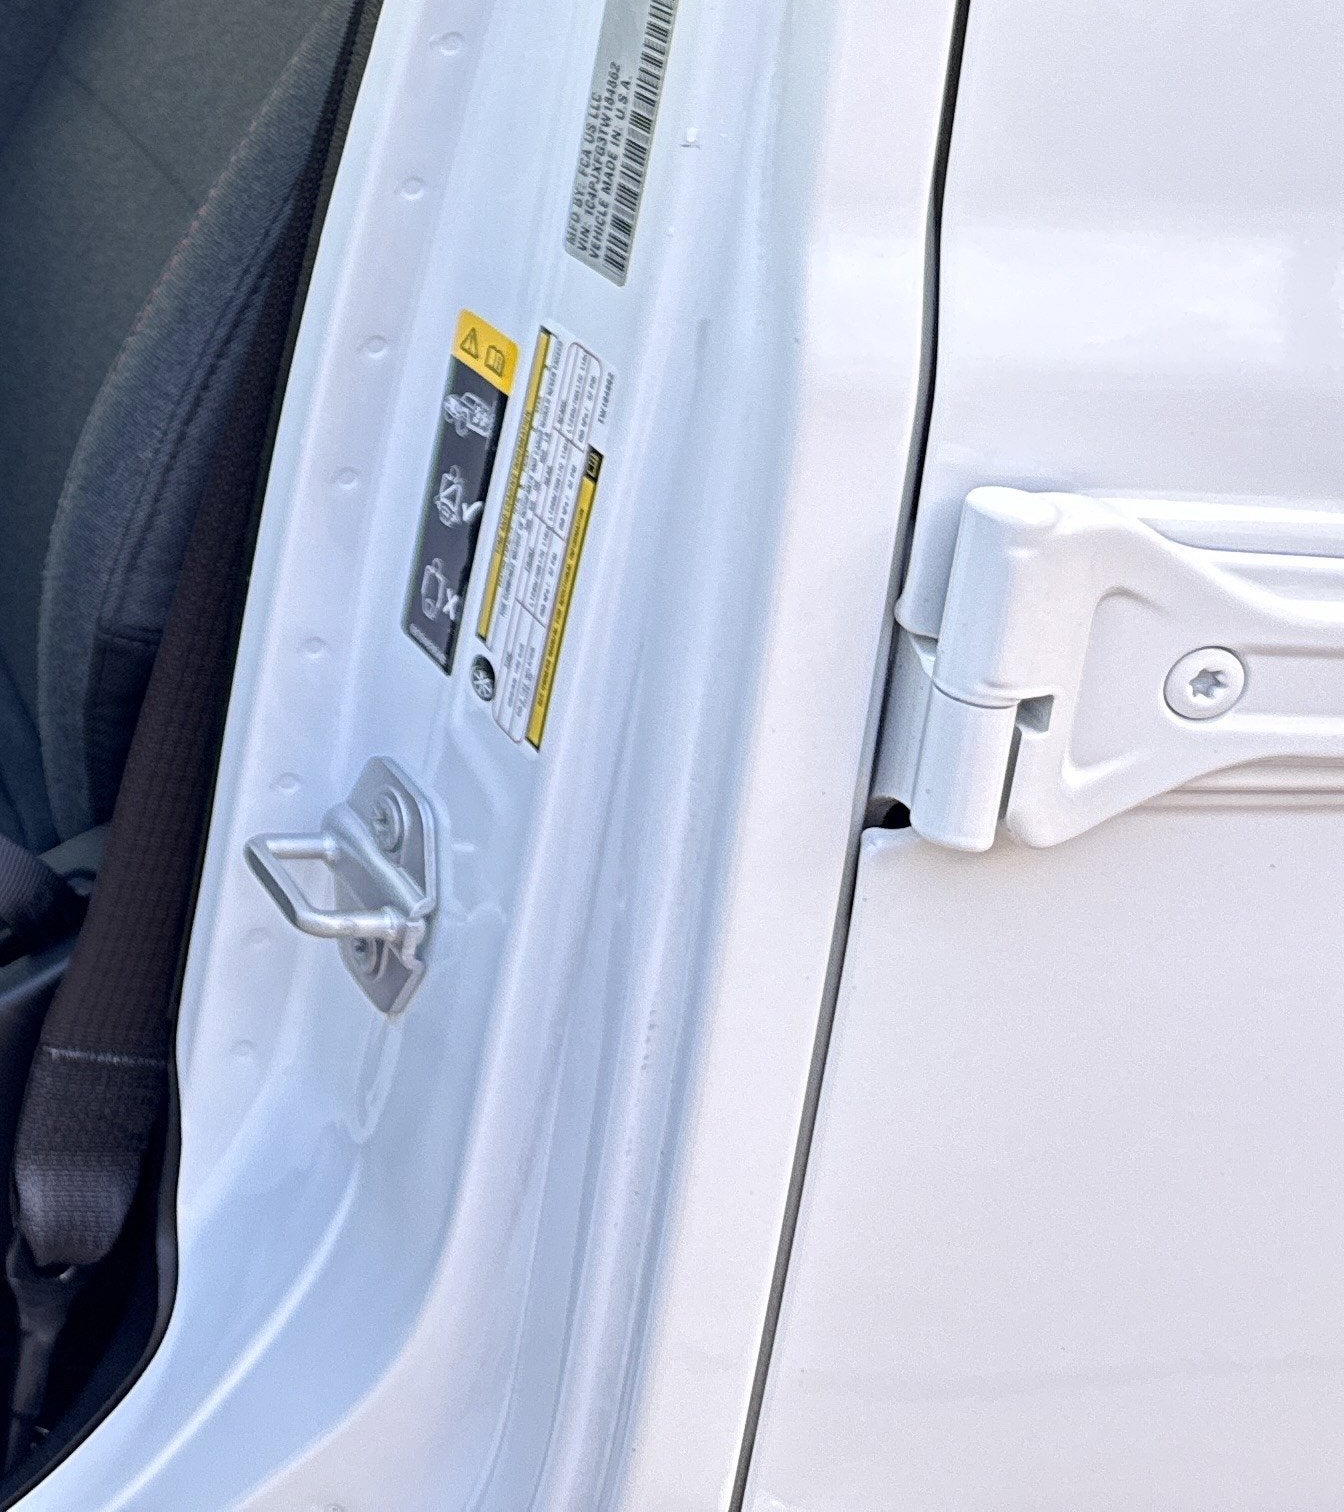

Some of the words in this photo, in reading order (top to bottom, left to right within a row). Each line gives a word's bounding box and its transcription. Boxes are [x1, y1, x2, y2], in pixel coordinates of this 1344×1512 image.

[587, 90, 602, 120] LLC
[583, 121, 597, 145] US
[577, 146, 592, 178] FCA
[587, 195, 609, 262] VEHICLE
[599, 148, 618, 196] MADE
